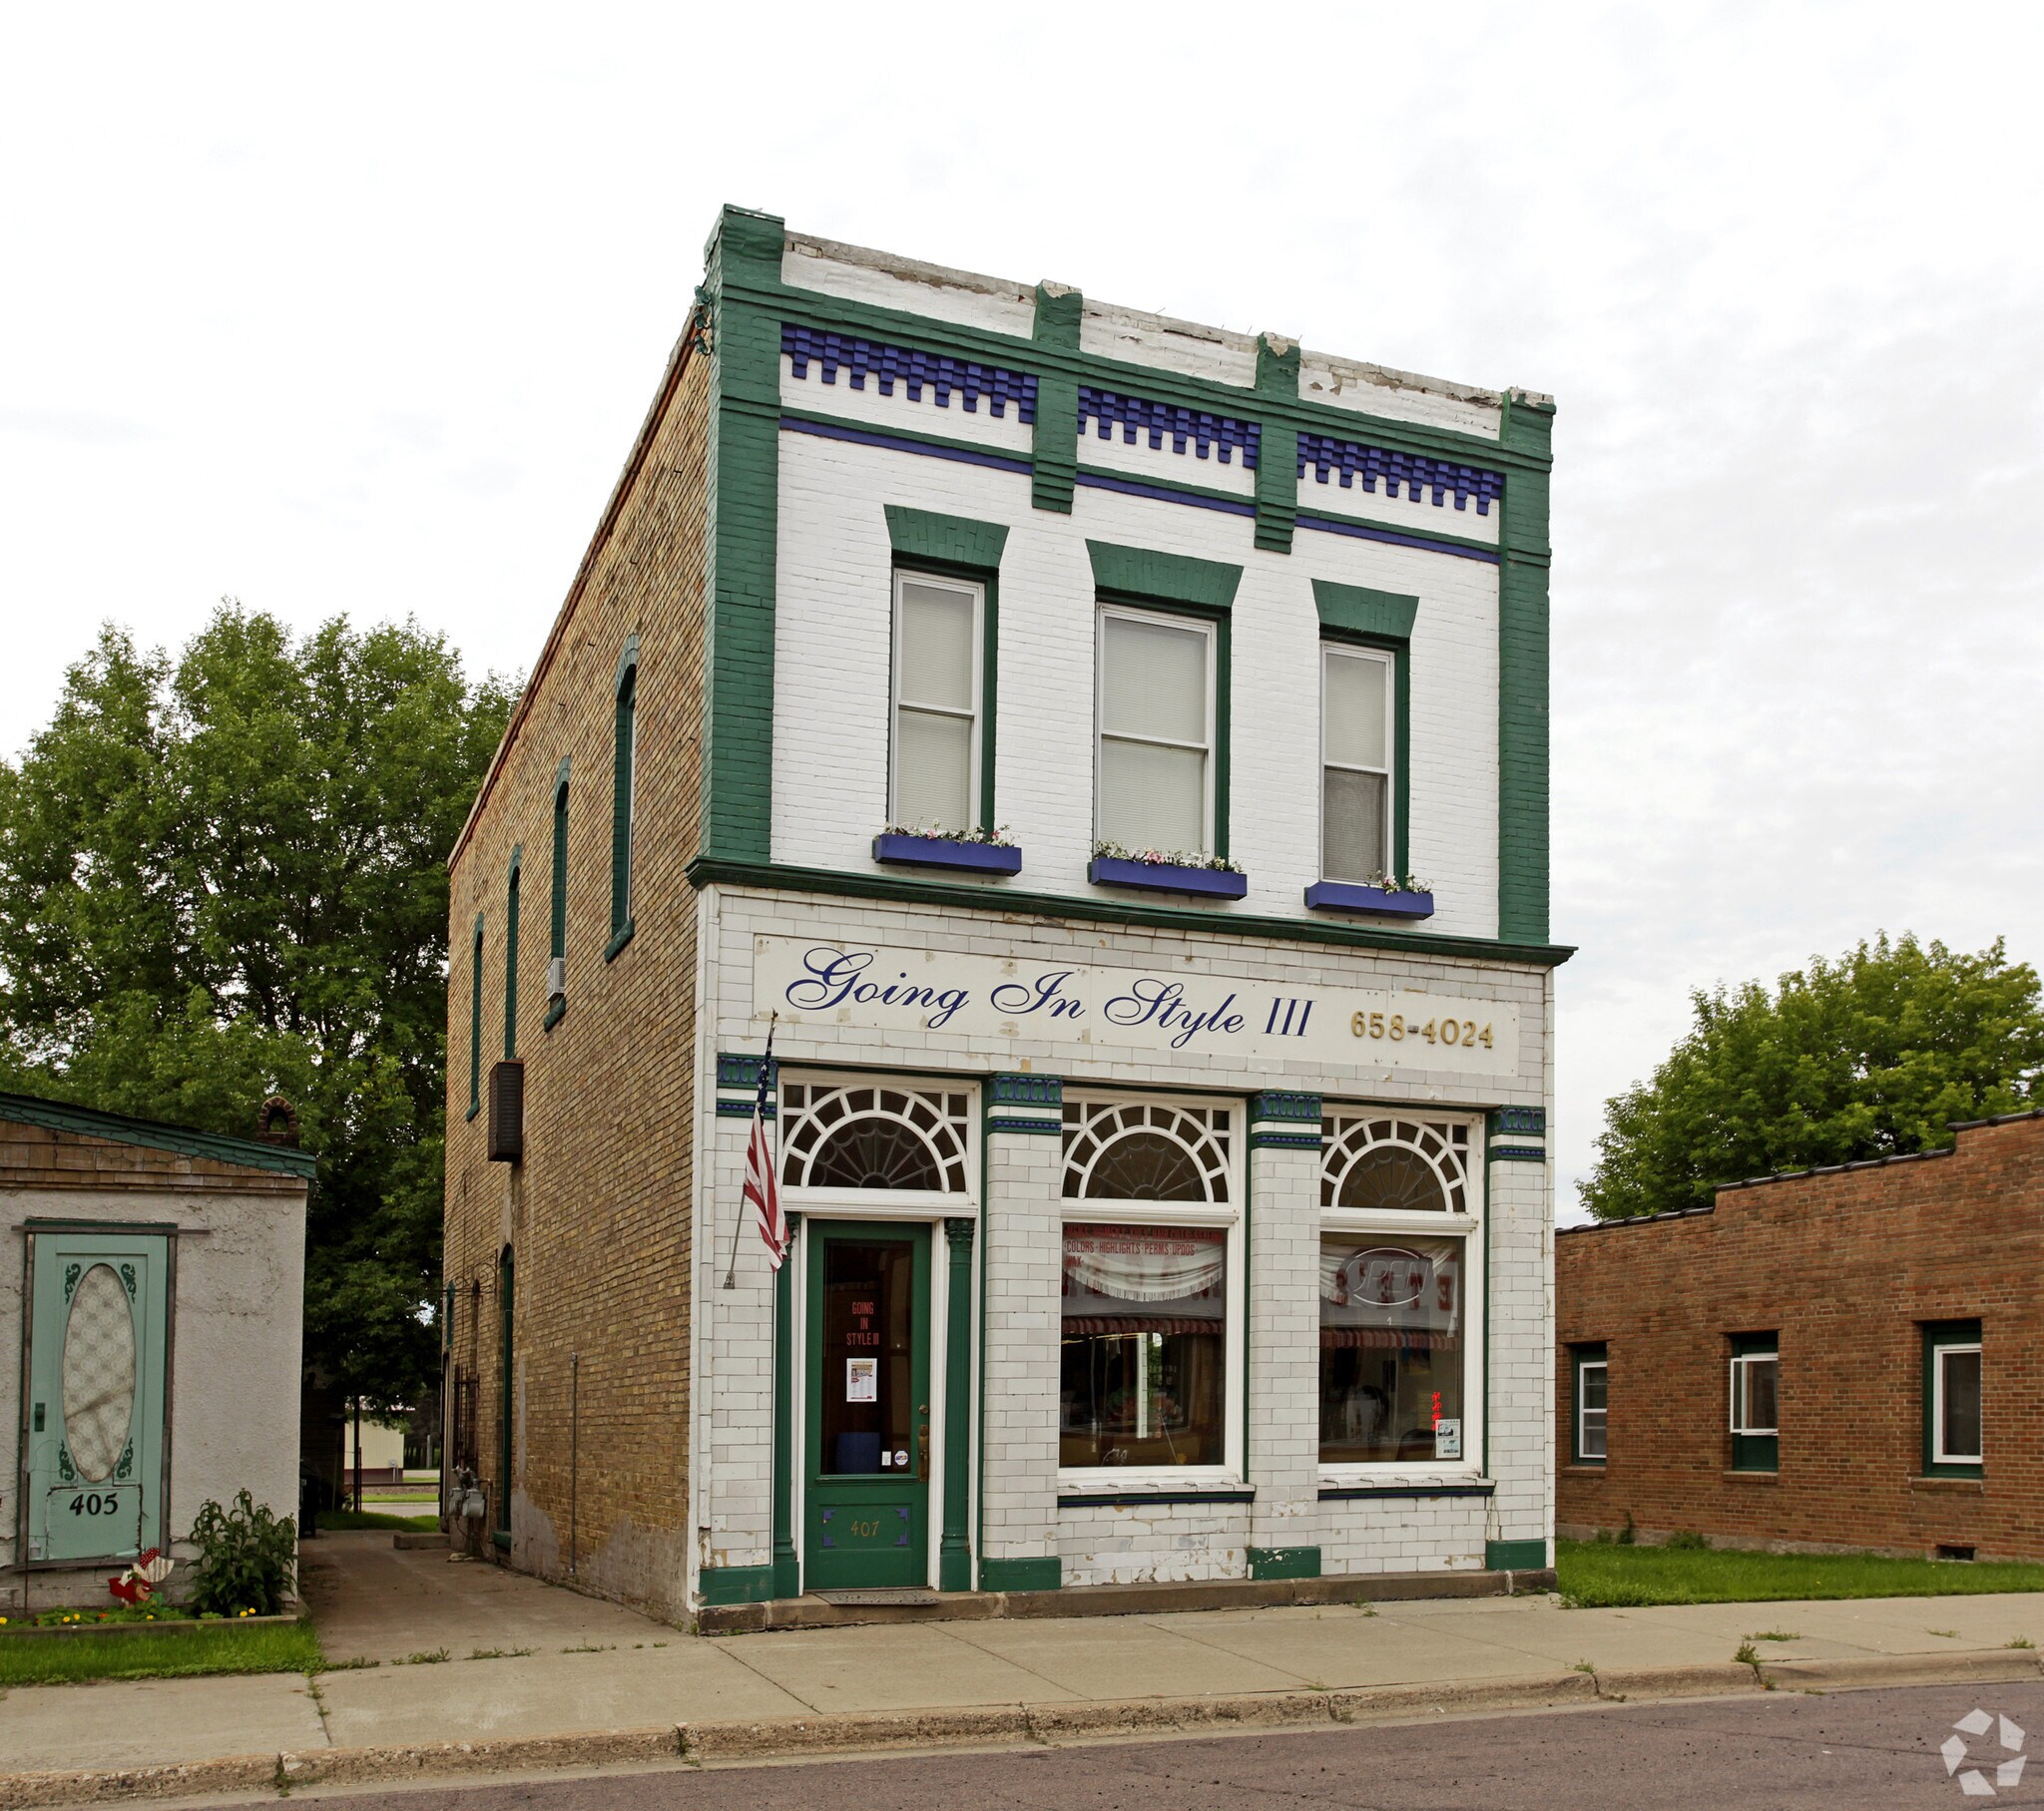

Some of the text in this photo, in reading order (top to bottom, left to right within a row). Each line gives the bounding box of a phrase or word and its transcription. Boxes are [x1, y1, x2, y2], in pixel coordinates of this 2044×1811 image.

[785, 947, 1317, 1049] Going In Style III
[1351, 1011, 1493, 1049] 658-4024
[1099, 1241, 1141, 1254] HIGHLIGHTS
[1144, 1242, 1169, 1255] PERMS
[1172, 1243, 1195, 1256] UPDOS
[1345, 1259, 1430, 1293] OPEN
[851, 1301, 874, 1315] GOING
[859, 1317, 868, 1330] IN
[846, 1332, 871, 1346] STYLE
[69, 1493, 118, 1516] 405
[850, 1520, 880, 1538] 407
